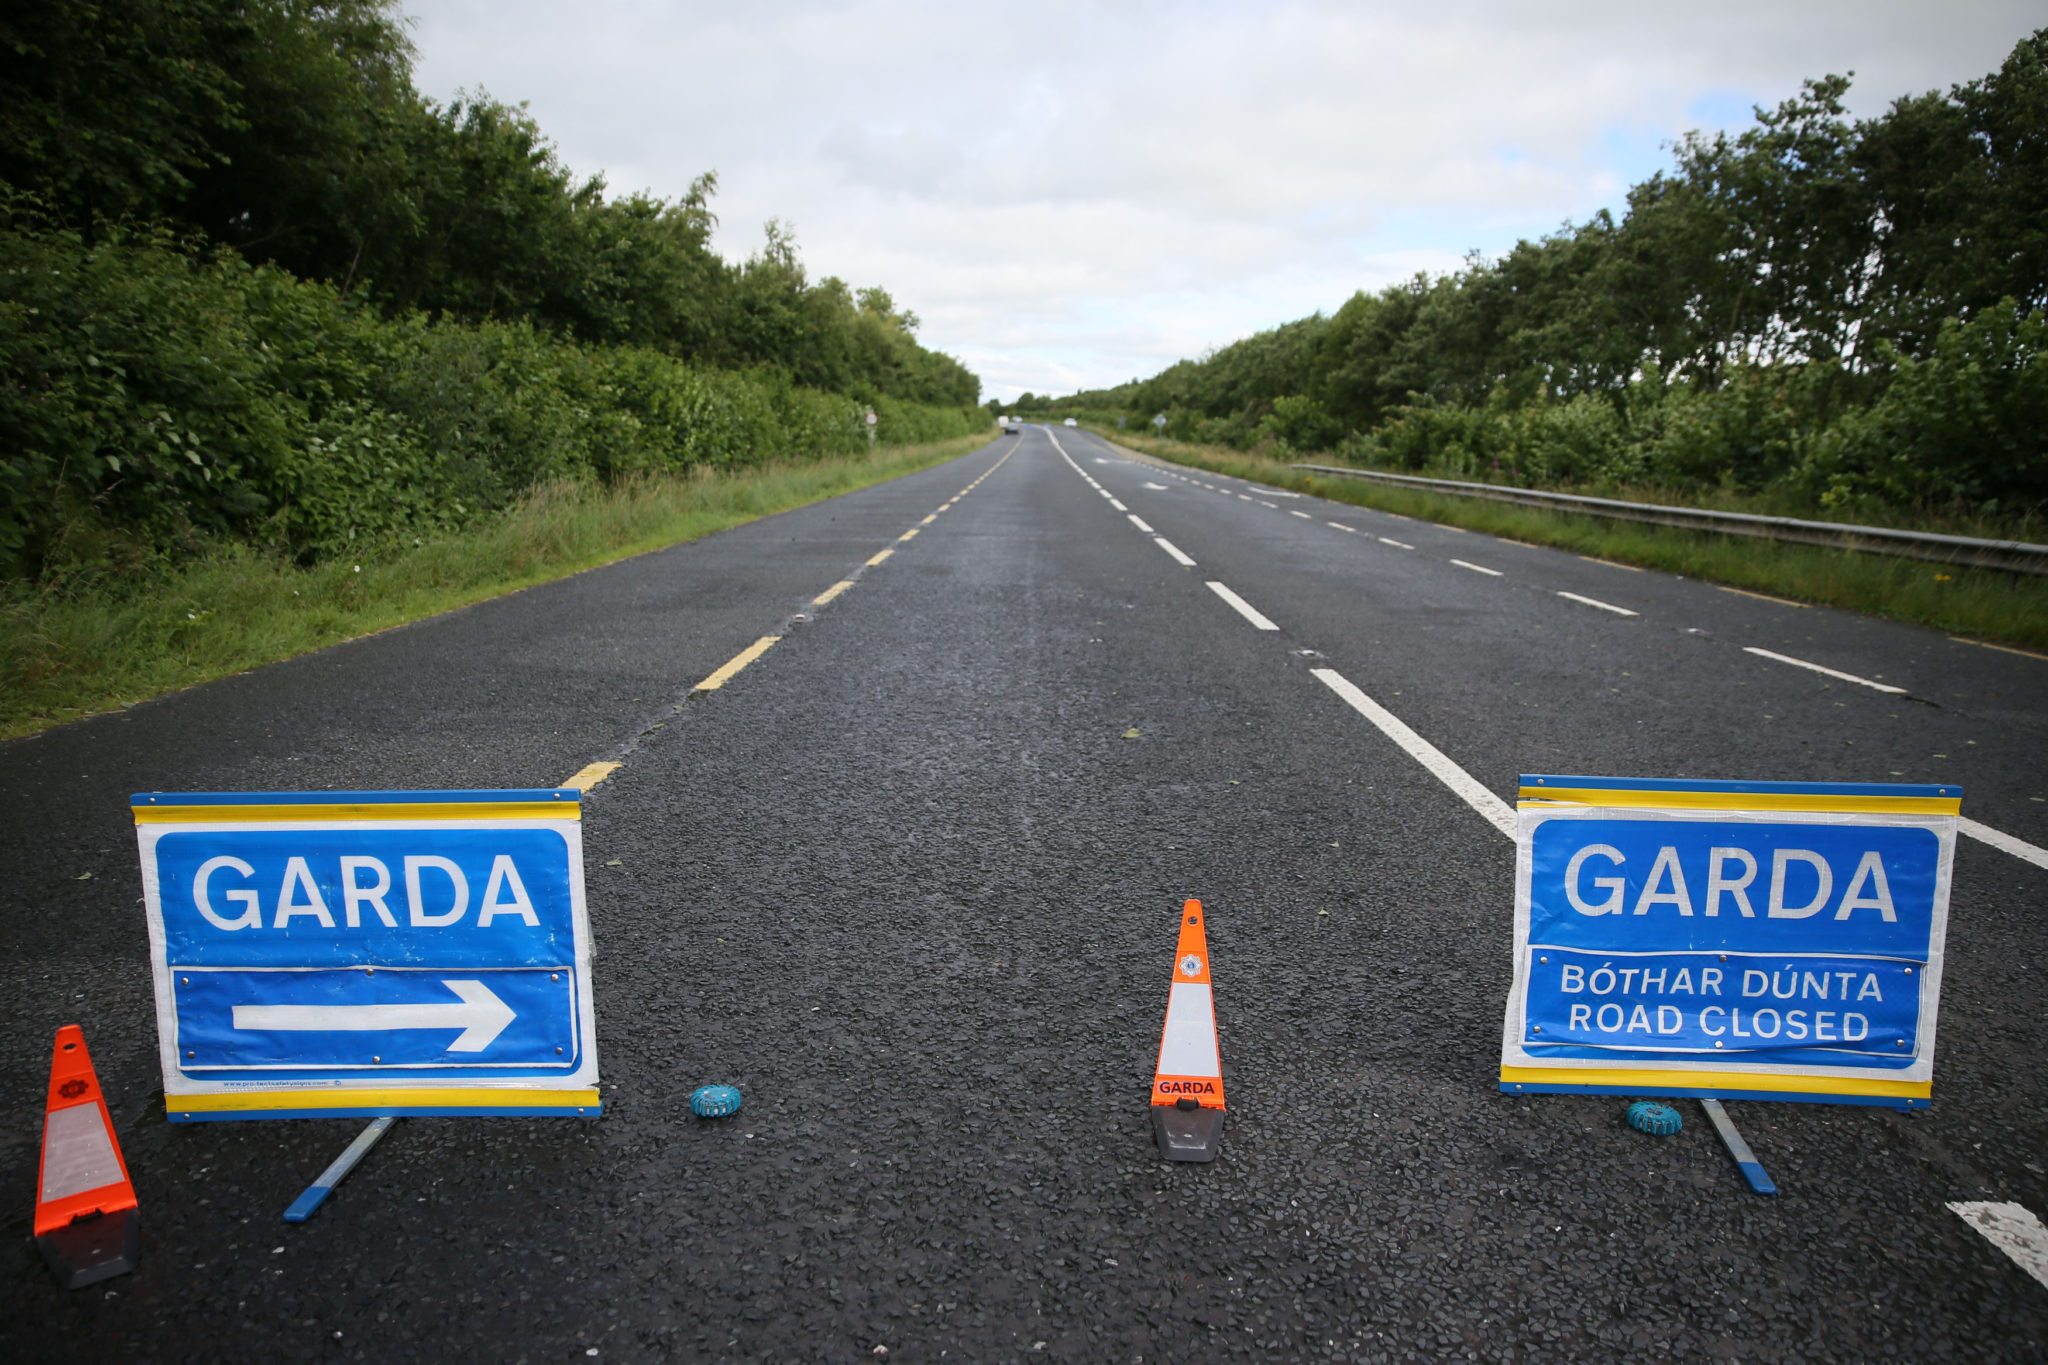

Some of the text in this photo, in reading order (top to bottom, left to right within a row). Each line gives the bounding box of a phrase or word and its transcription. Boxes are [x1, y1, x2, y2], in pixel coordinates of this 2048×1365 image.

[193, 855, 541, 931] GARDA
[1565, 843, 1898, 922] GARDA
[1561, 962, 1883, 1003] BÓTHAR DÚNTA
[1569, 1003, 1869, 1041] ROAD CLOSED
[1160, 1081, 1215, 1094] GARDA
